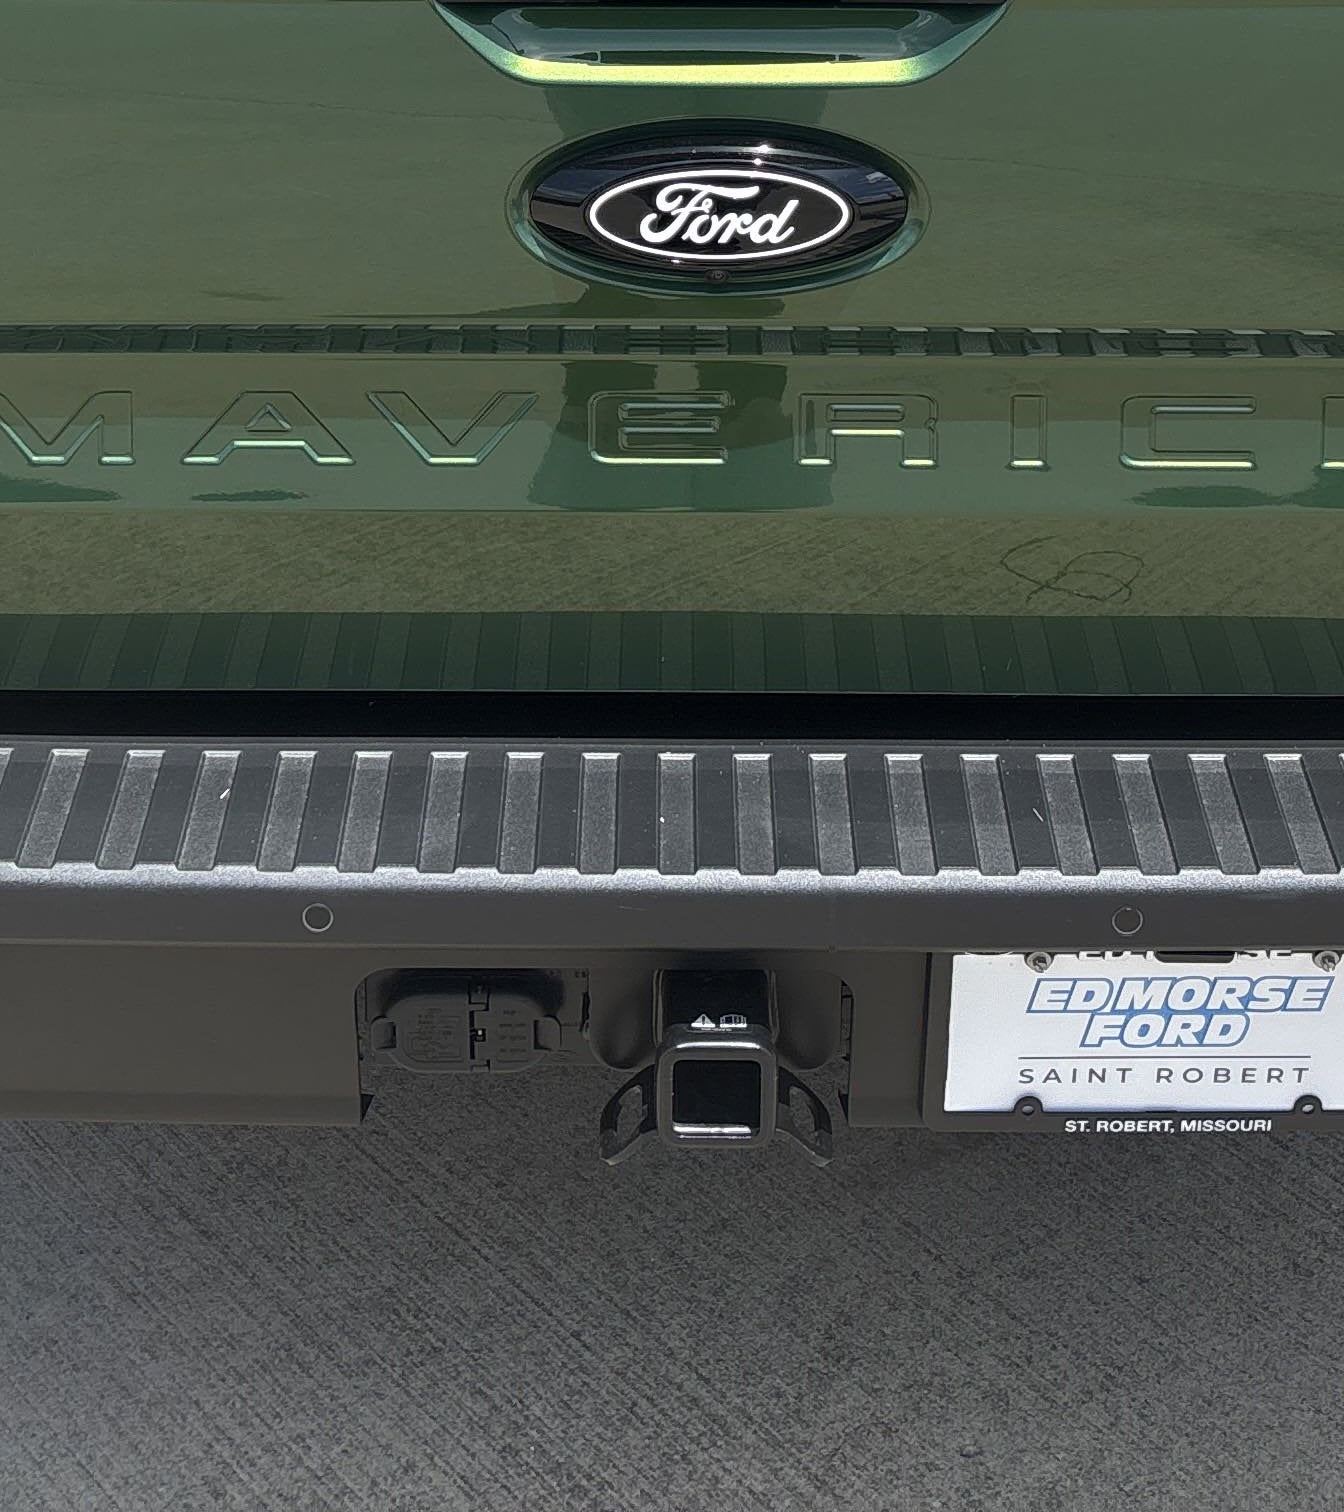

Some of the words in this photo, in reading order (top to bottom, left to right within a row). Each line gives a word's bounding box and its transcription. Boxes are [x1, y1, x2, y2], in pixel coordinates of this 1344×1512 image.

[638, 182, 800, 245] Ford
[1026, 977, 1116, 1014] ED
[1115, 976, 1335, 1013] MORSE
[1079, 1011, 1251, 1048] FORD
[1018, 1066, 1133, 1085] SAINT
[1156, 1066, 1311, 1085] ROBERT
[1064, 1119, 1092, 1133] ST.
[1096, 1119, 1176, 1136] ROBERT,
[1179, 1119, 1272, 1134] MISSOURI
